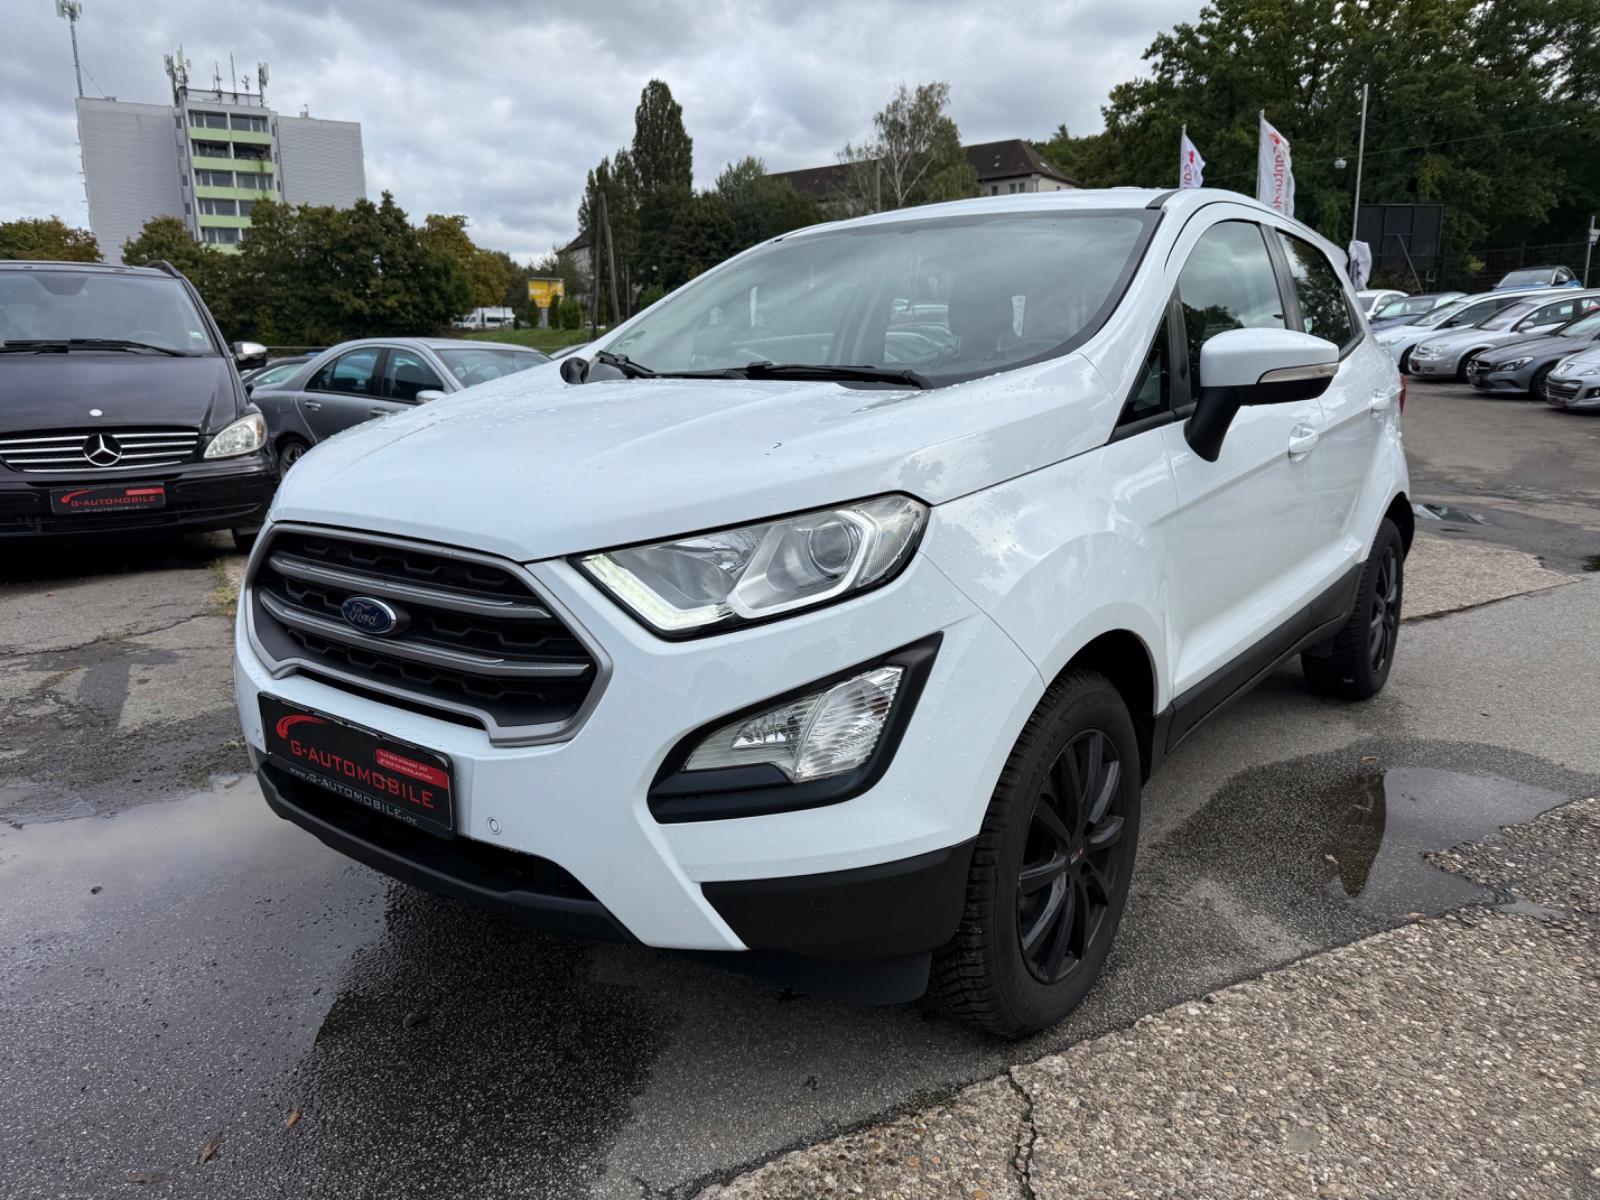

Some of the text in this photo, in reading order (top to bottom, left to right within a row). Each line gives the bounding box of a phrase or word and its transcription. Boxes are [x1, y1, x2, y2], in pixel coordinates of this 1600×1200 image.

[71, 496, 156, 507] G-AUTOMOBILE
[349, 602, 380, 626] Ford
[290, 740, 435, 809] G-AUTOMOBILE
